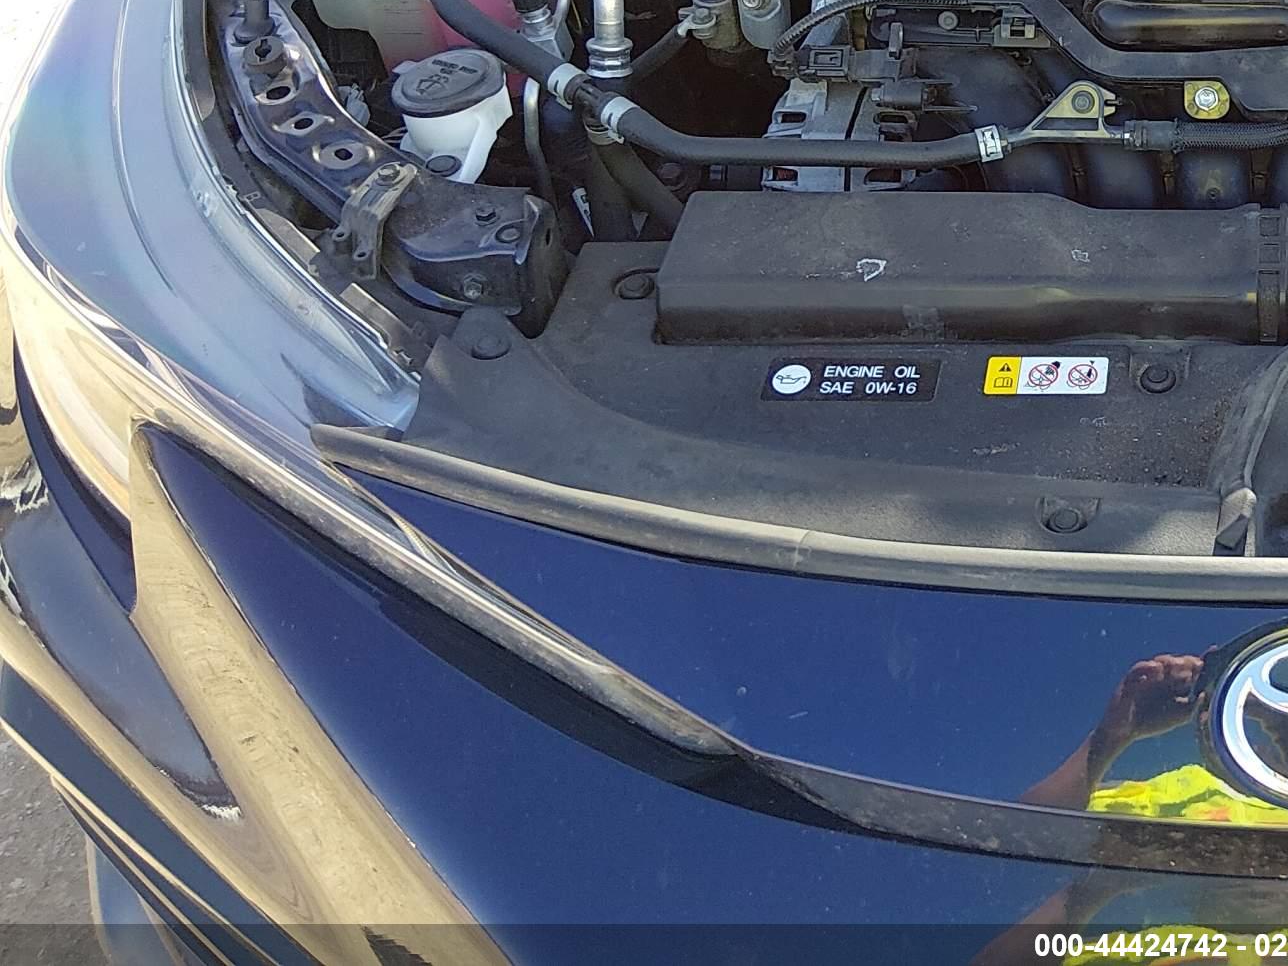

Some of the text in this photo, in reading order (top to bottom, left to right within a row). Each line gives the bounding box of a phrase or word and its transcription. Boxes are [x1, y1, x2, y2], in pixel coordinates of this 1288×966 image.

[822, 365, 921, 379] ENGINE OIL
[819, 381, 917, 394] SAE 0W-16
